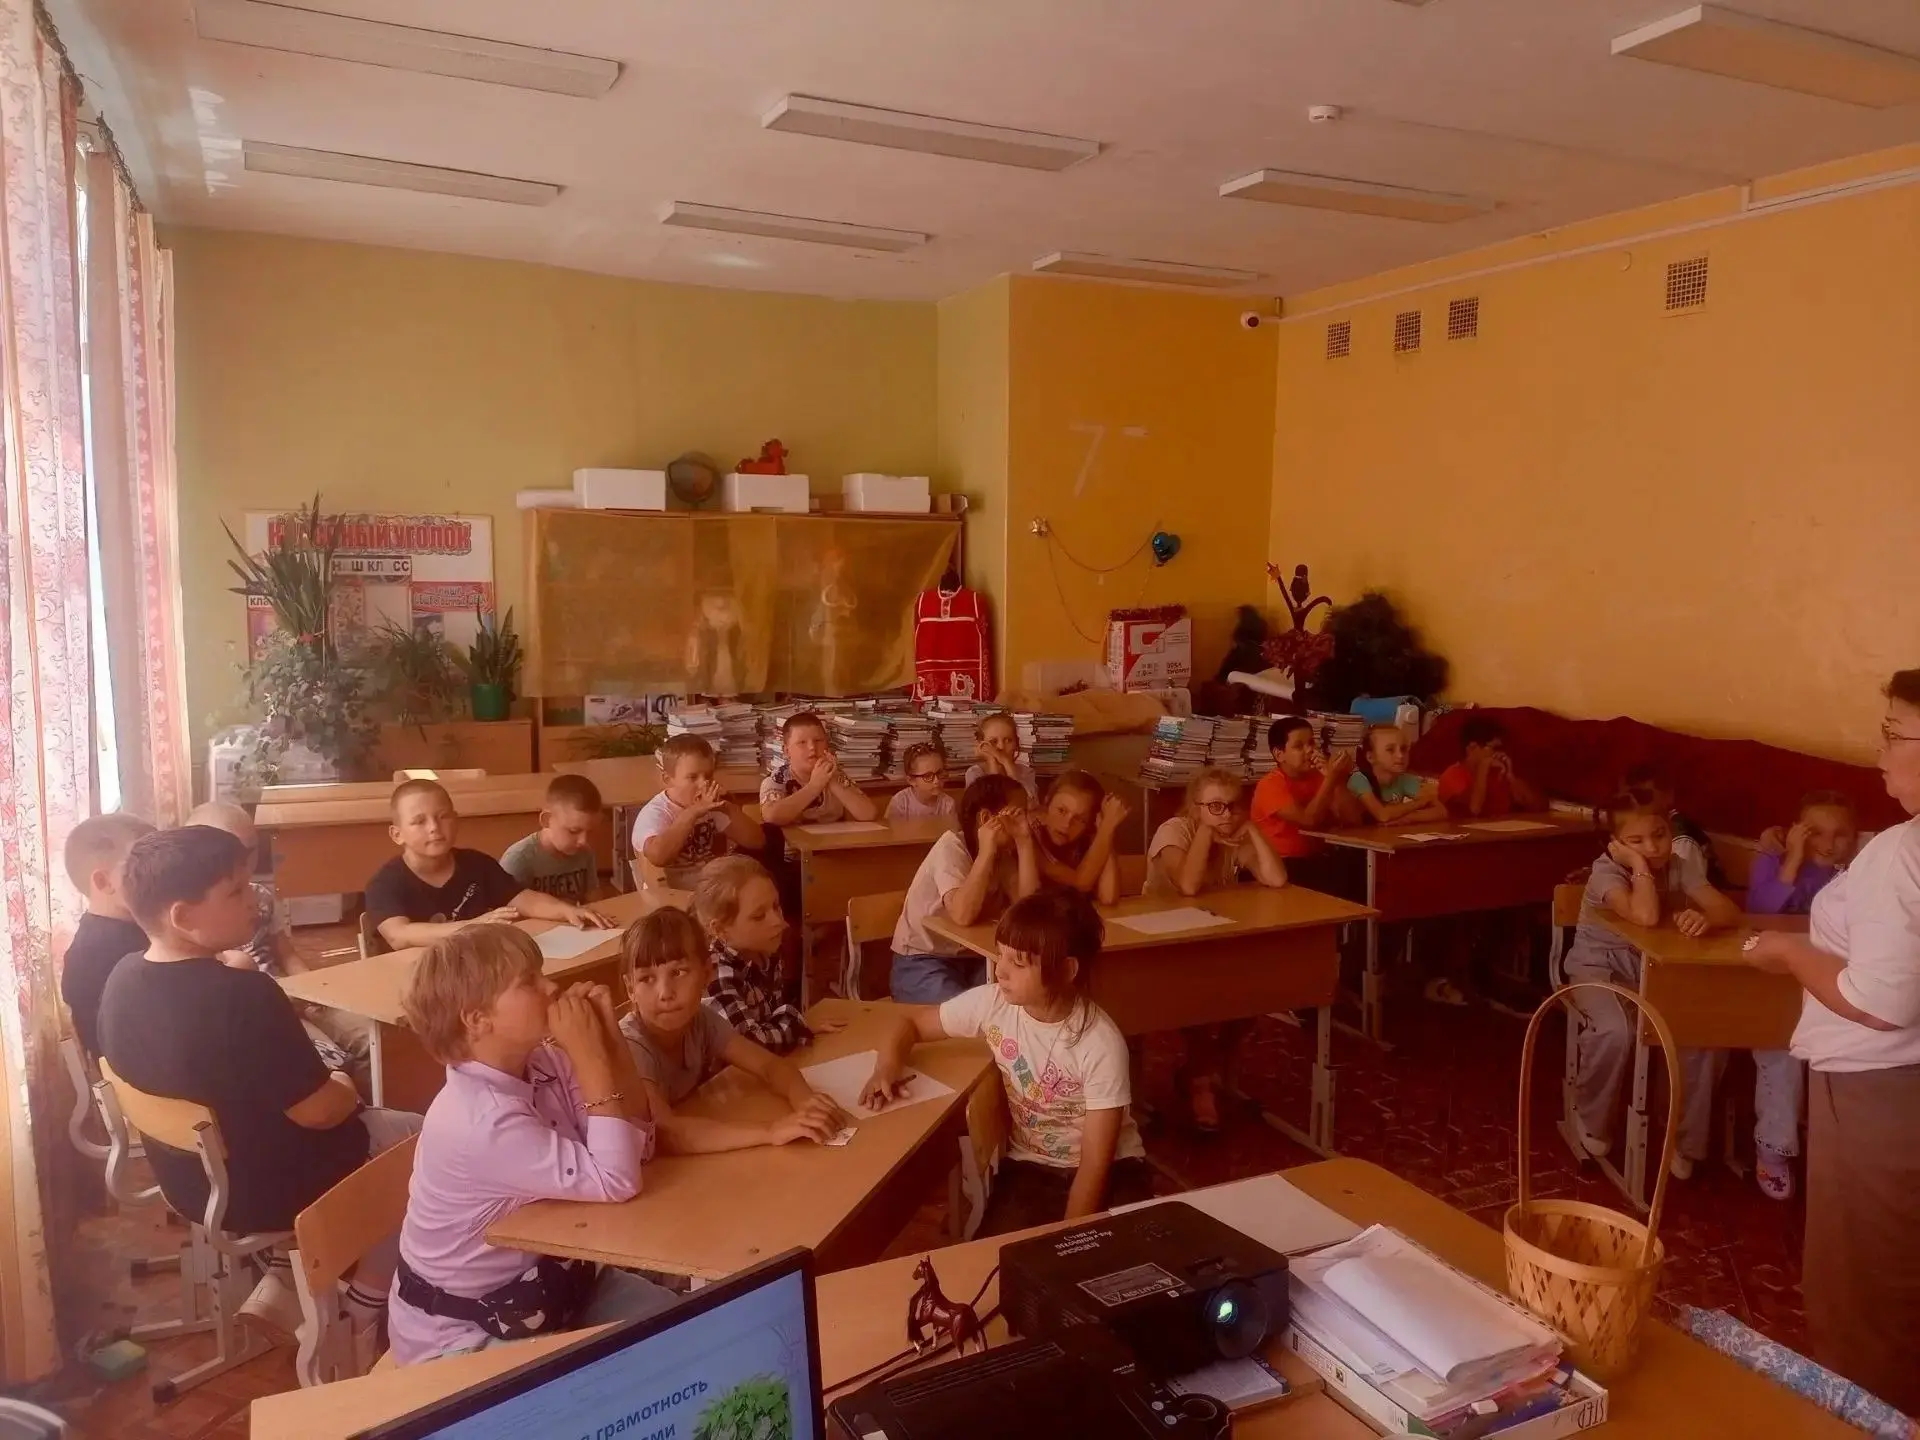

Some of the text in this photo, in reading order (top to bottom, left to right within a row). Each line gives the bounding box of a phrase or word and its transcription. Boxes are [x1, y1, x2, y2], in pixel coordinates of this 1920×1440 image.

[391, 522, 471, 551] УГОЛОК
[367, 560, 410, 572] КЛСС
[597, 1380, 708, 1440] грамотность
